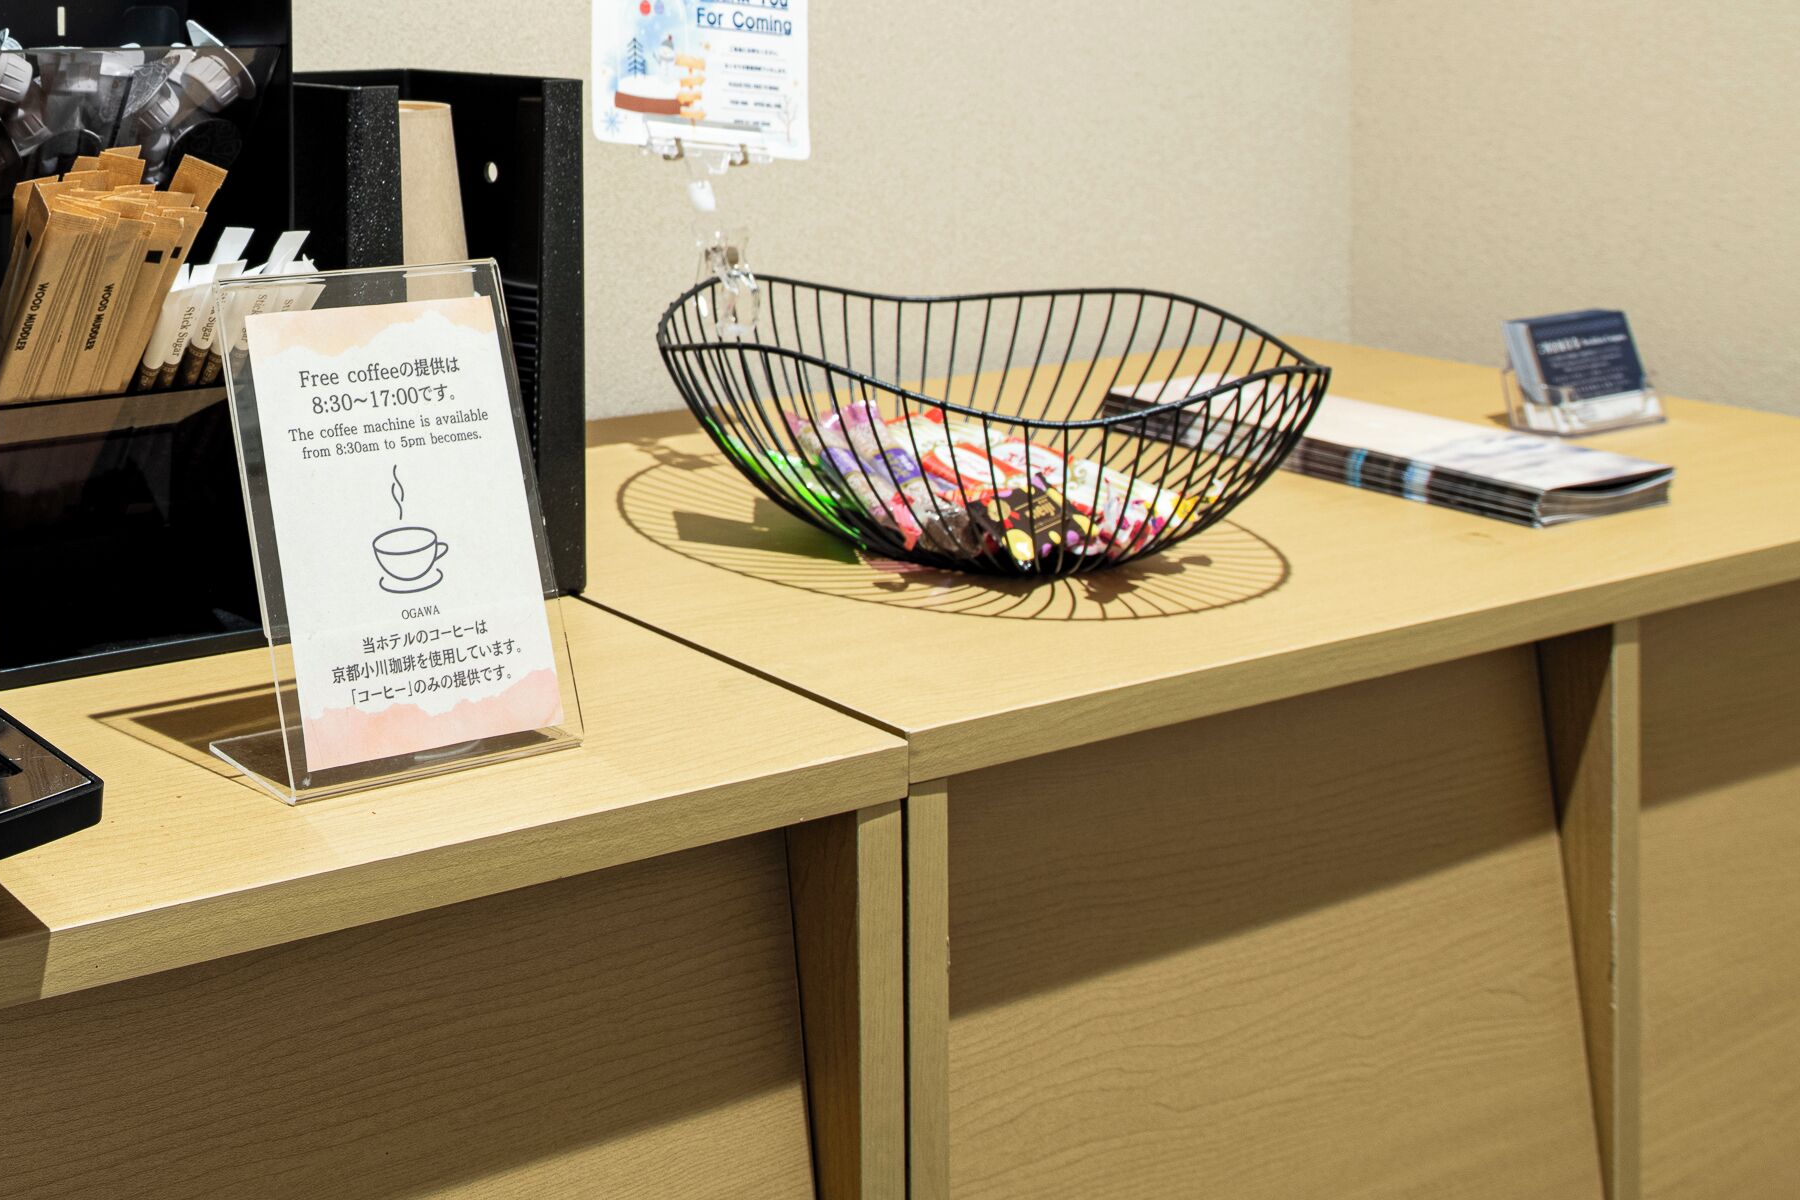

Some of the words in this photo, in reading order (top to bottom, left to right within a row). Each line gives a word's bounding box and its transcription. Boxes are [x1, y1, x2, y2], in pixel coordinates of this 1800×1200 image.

[697, 7, 723, 26] For
[732, 11, 792, 36] Coming
[31, 281, 50, 312] WOOD
[97, 282, 115, 312] WOOD
[14, 313, 38, 351] MUDDLER
[83, 313, 106, 351] MUDDLER
[179, 306, 196, 330] Stick
[201, 316, 217, 342] Sugar
[172, 330, 189, 357] Sugar
[298, 370, 340, 388] Free
[347, 356, 461, 383] coffeeの提供は
[288, 427, 314, 442] The
[320, 423, 358, 439] coffee
[363, 416, 416, 434] machine
[419, 414, 431, 427] is
[435, 408, 489, 426] available
[302, 445, 331, 460] from
[335, 440, 380, 456] 8:30am
[384, 438, 396, 450] to
[400, 435, 426, 449] 5pm
[430, 429, 482, 445] becomes.
[401, 604, 440, 620] OGAWA
[362, 619, 488, 655] 当ホテルのコーヒーは
[331, 637, 522, 685] 京都小川珈琲を使用しています。
[351, 664, 512, 706] 「コーヒー」のみの提供です。
